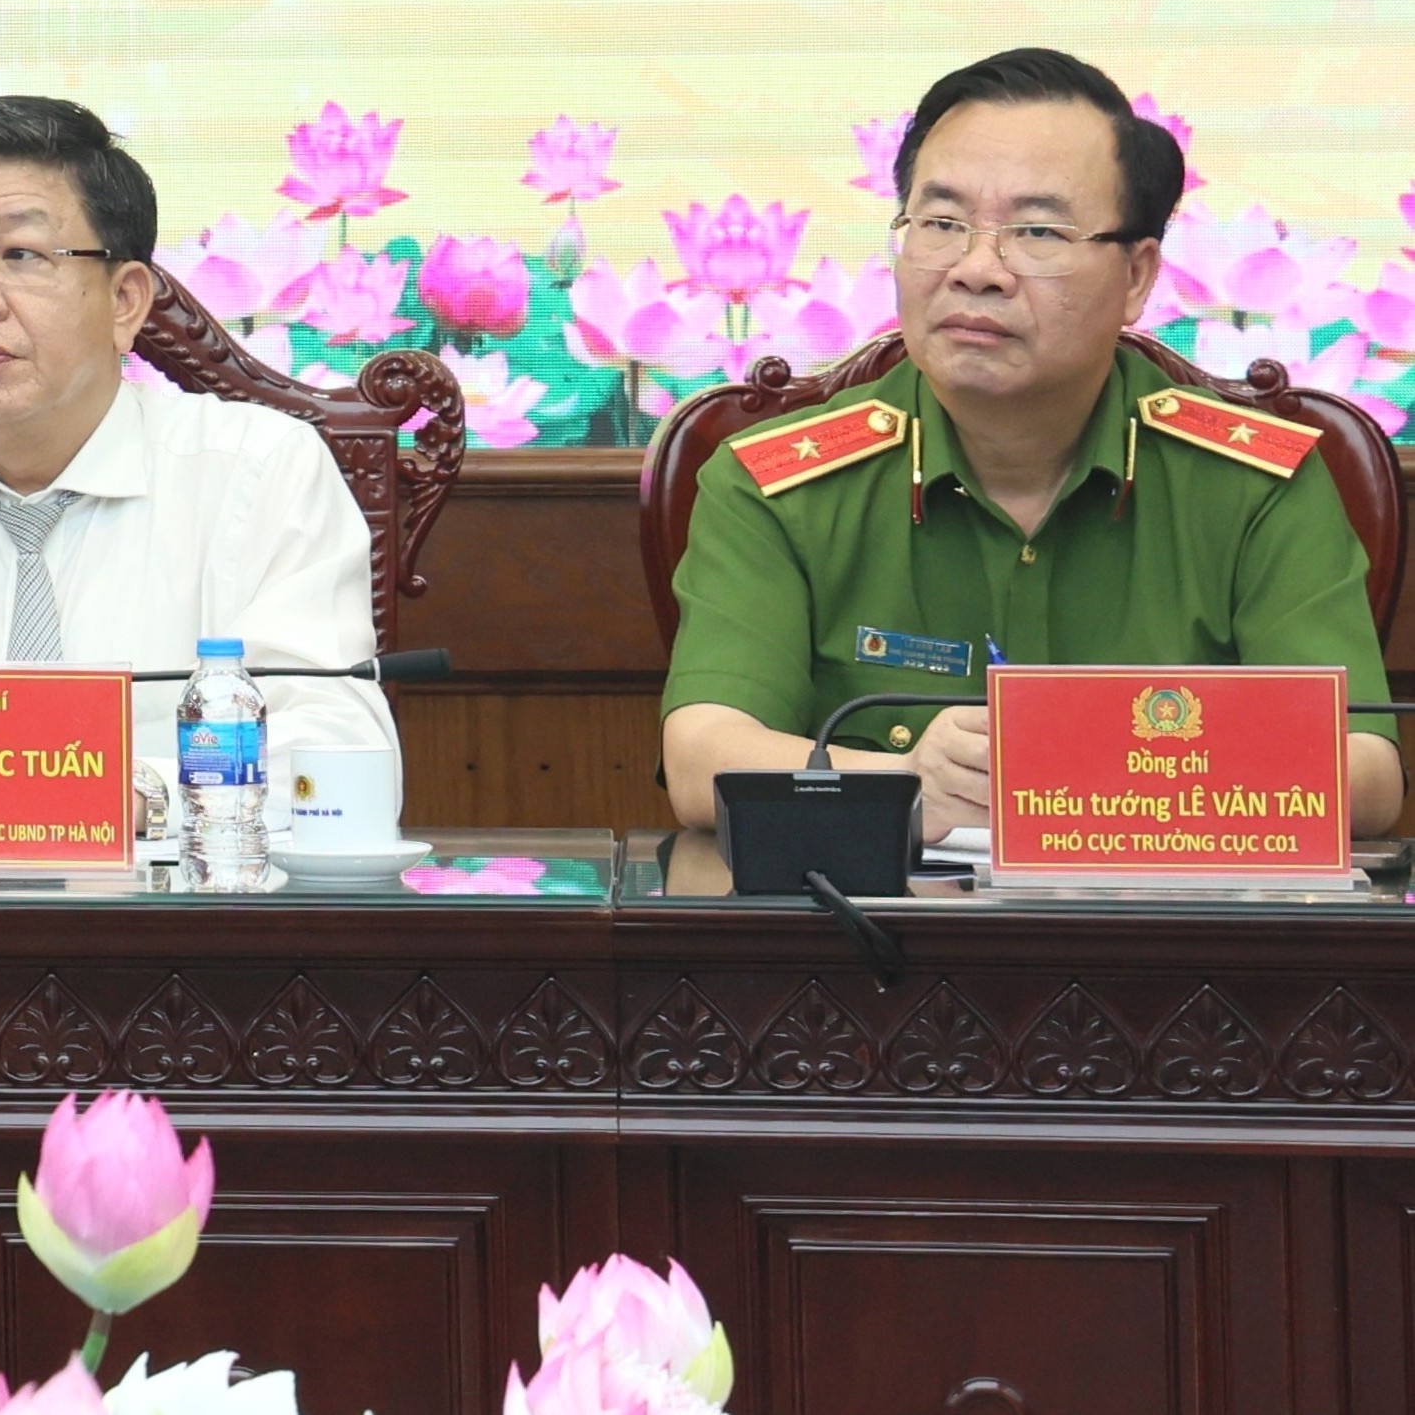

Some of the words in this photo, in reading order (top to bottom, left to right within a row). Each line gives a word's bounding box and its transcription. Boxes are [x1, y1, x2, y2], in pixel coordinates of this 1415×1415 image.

[21, 740, 104, 778] TUẤN
[1126, 747, 1178, 779] Đồng
[1181, 750, 1209, 774] chí
[1012, 786, 1084, 816] Thiếu
[1089, 789, 1172, 823] tướng
[1178, 784, 1206, 817] LÊ
[1212, 784, 1268, 817] VĂN
[1273, 785, 1326, 818] TÂN
[7, 824, 48, 842] UBND
[48, 824, 67, 841] TP
[68, 820, 88, 842] HÀ
[92, 820, 116, 846] NỘI
[1041, 830, 1083, 852] PHÓ
[1086, 833, 1126, 854] CỤC
[1129, 829, 1216, 852] TRƯỞNG
[1219, 834, 1259, 855] CỤC
[1263, 834, 1299, 853] C01
